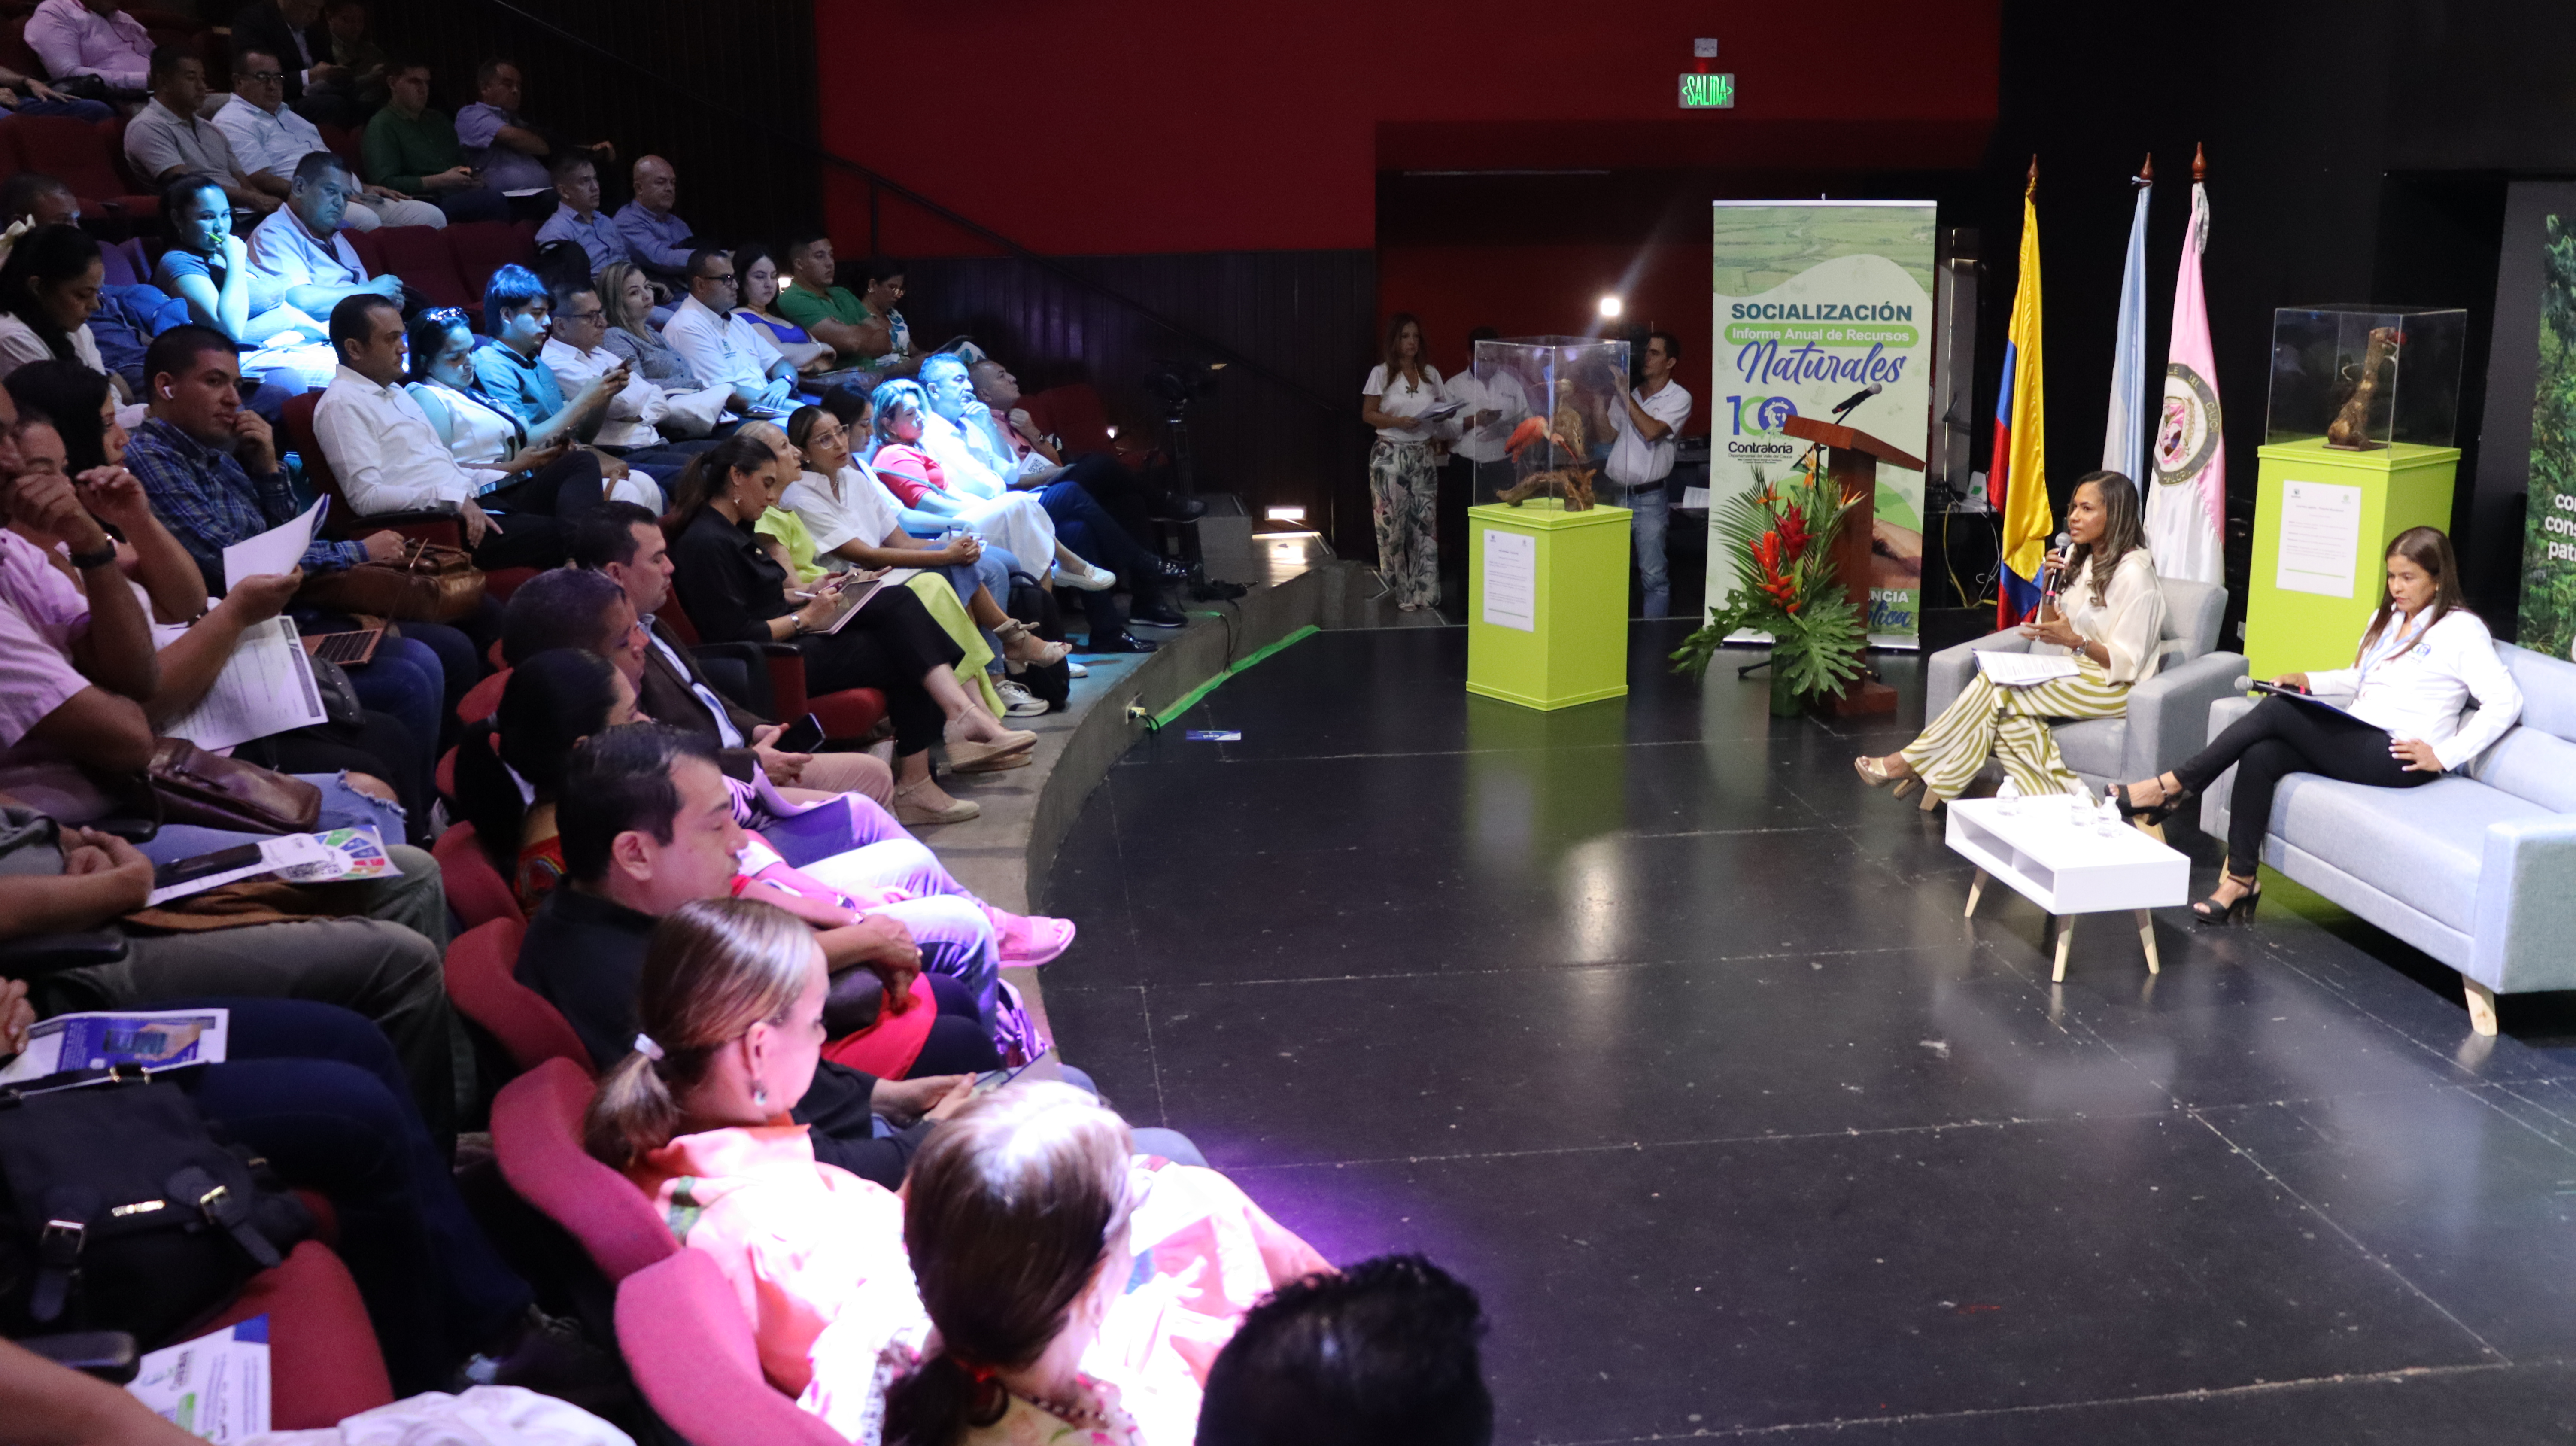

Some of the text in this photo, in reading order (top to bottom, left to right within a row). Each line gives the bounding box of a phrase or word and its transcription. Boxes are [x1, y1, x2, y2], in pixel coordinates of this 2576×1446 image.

[1687, 76, 1727, 105] SALIDA
[1732, 301, 1912, 321] SOCIALIZACIÓN
[1732, 328, 1910, 341] Informe Anual de Recursos
[1737, 339, 1907, 384] Naturales
[1728, 441, 1793, 454] Contraloría
